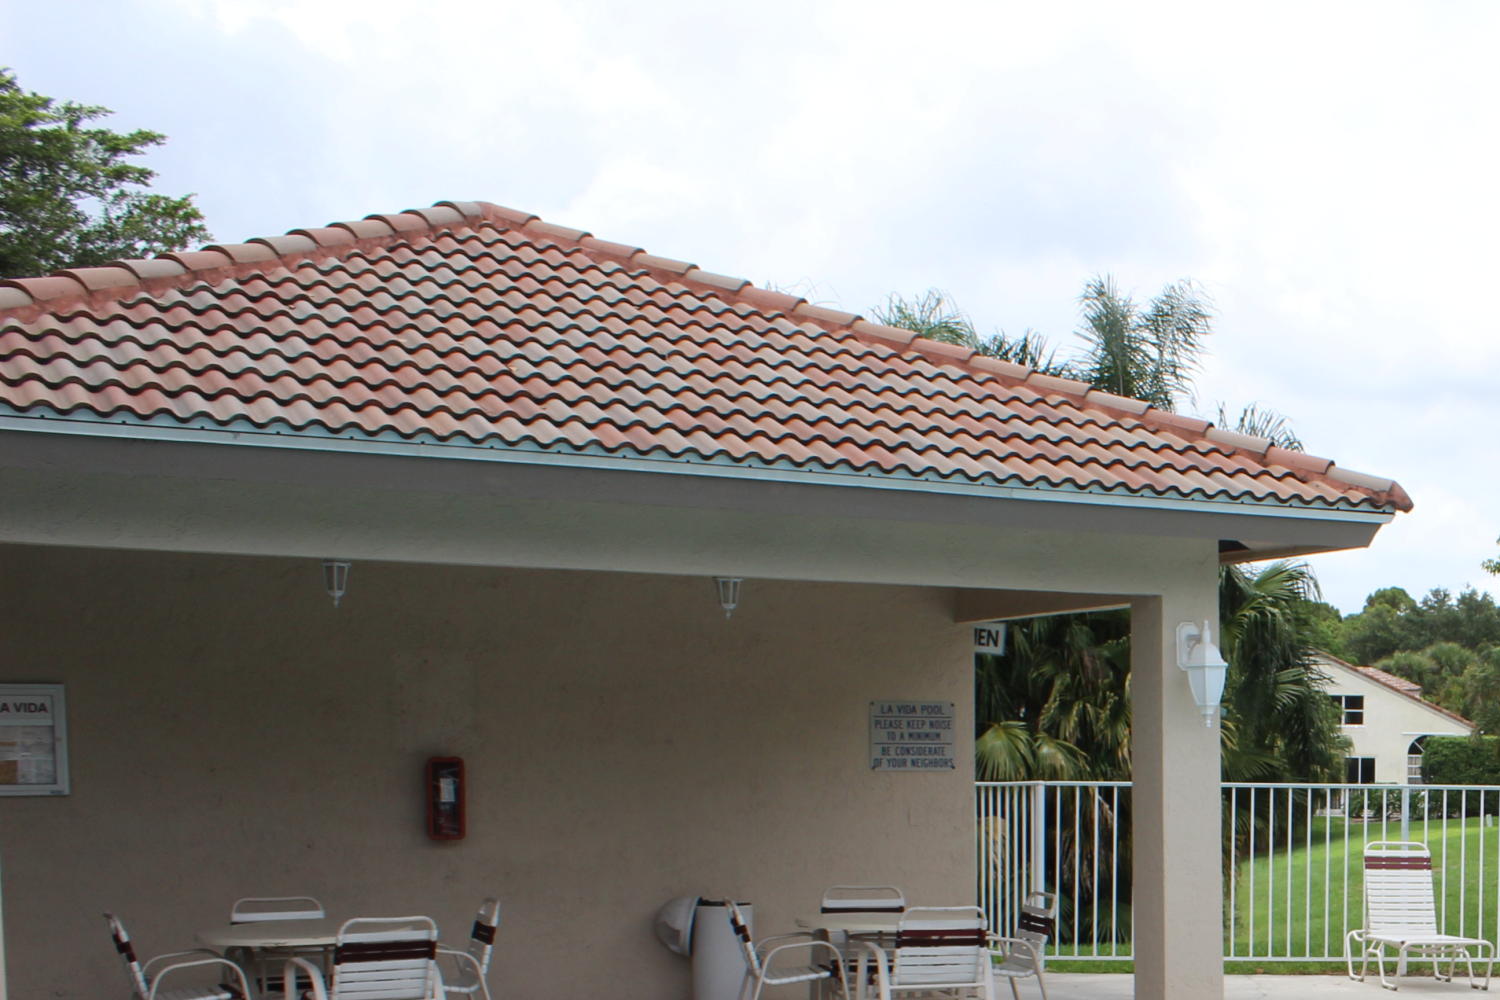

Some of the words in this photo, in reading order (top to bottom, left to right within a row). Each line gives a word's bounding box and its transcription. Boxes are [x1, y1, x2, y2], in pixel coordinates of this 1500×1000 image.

[974, 627, 999, 648] EN
[14, 702, 48, 713] VIDA
[881, 704, 893, 714] LA
[896, 704, 917, 714] VIDA
[920, 704, 945, 715] POOL
[874, 719, 904, 729] PLEASE
[906, 719, 926, 729] KEEP
[928, 719, 952, 730] NOISE
[887, 731, 896, 741] TO
[900, 731, 905, 741] A
[881, 746, 891, 756] BE
[895, 746, 945, 756] CONSIDERATE
[873, 758, 882, 768] OF
[886, 758, 907, 768] YOUR
[910, 758, 953, 768] NEIGHBORS
